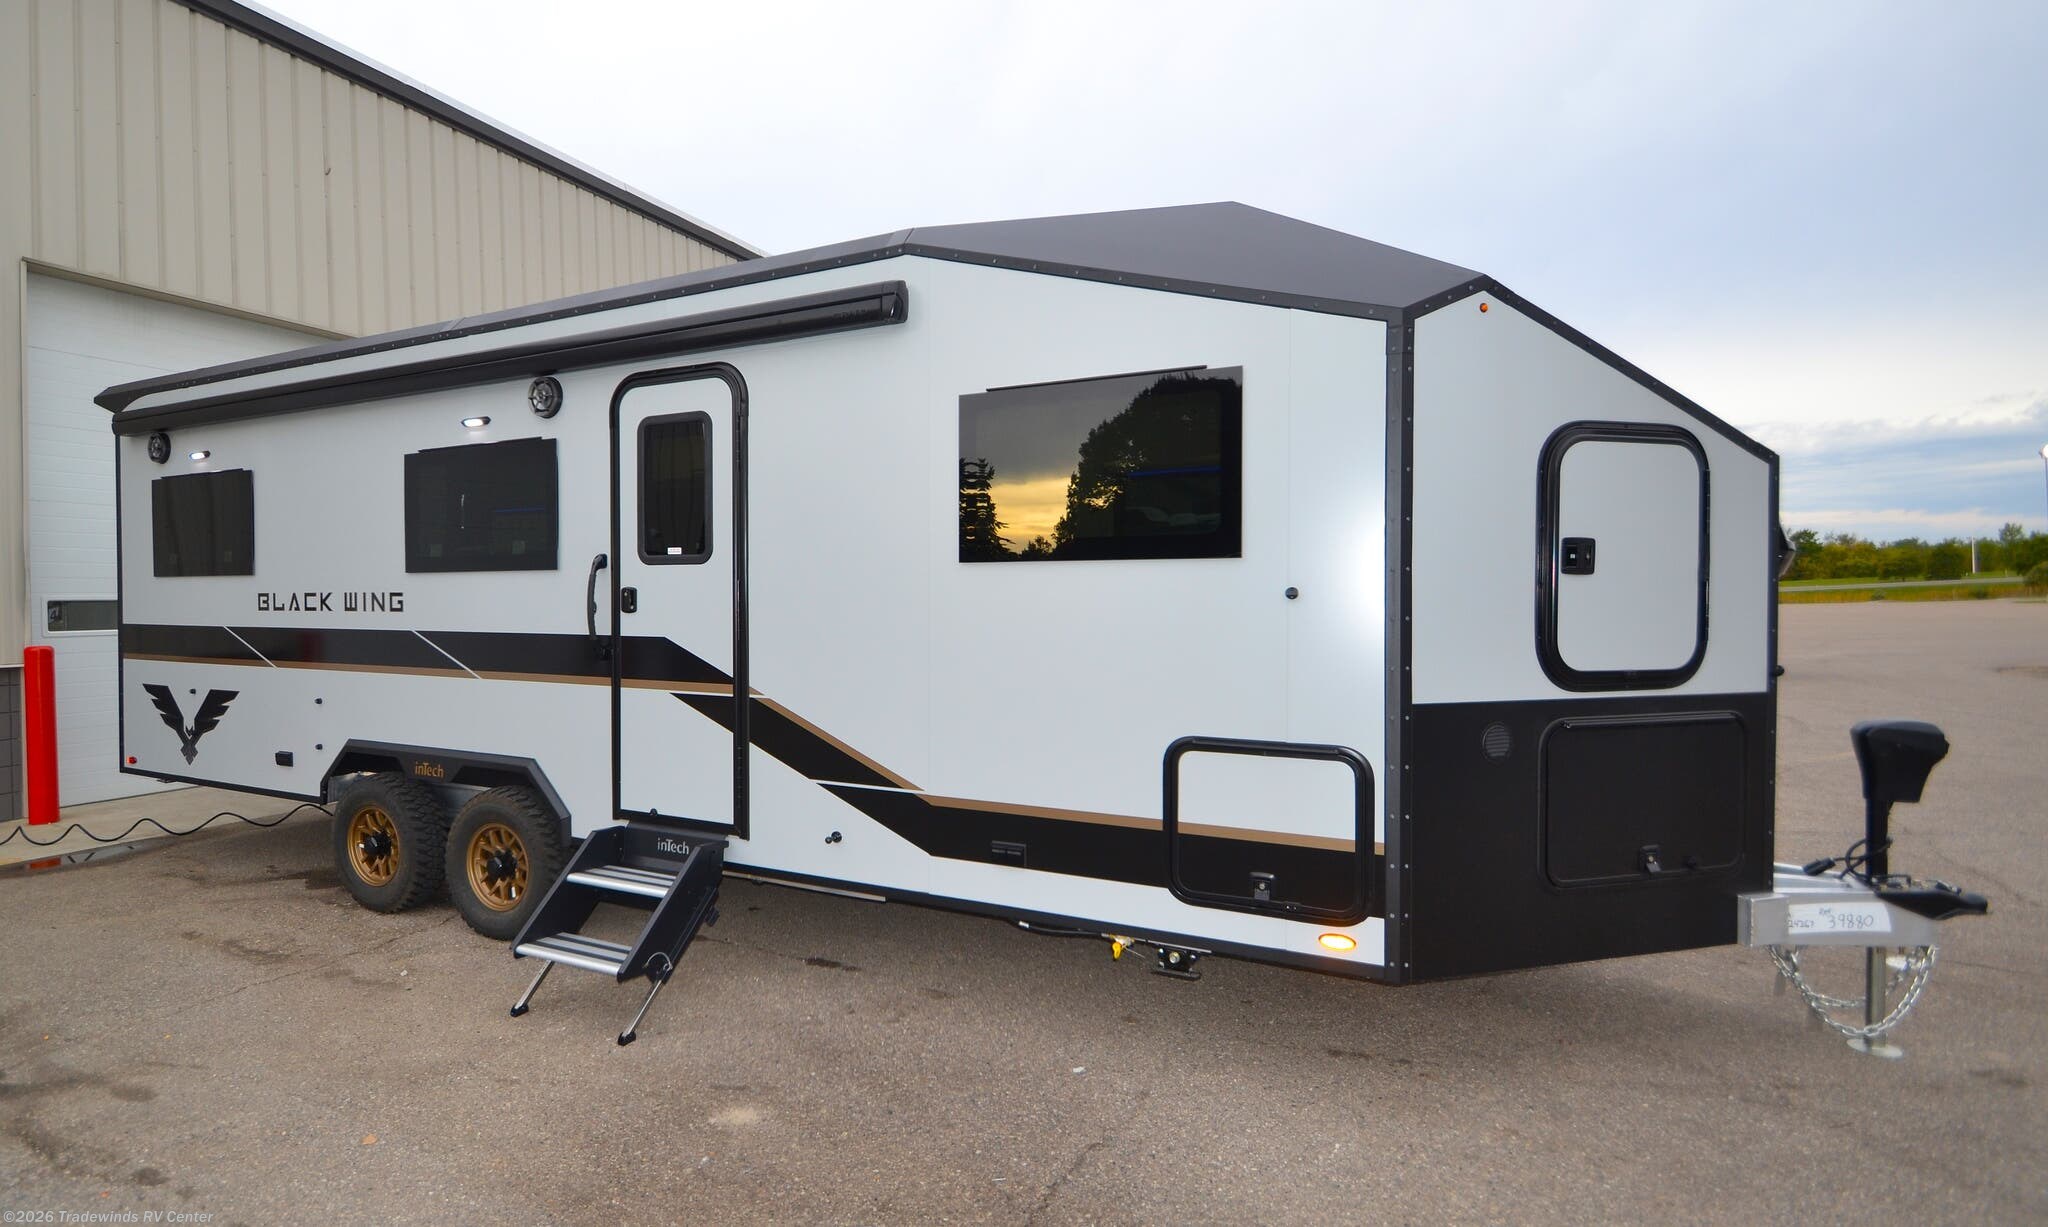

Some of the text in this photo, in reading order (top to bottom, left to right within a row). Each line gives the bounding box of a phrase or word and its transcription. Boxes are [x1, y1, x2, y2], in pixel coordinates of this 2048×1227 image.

[257, 592, 403, 611] BLACK WING
[415, 761, 444, 777] inTech
[657, 837, 689, 854] inTech
[1829, 913, 1874, 928] 39880
